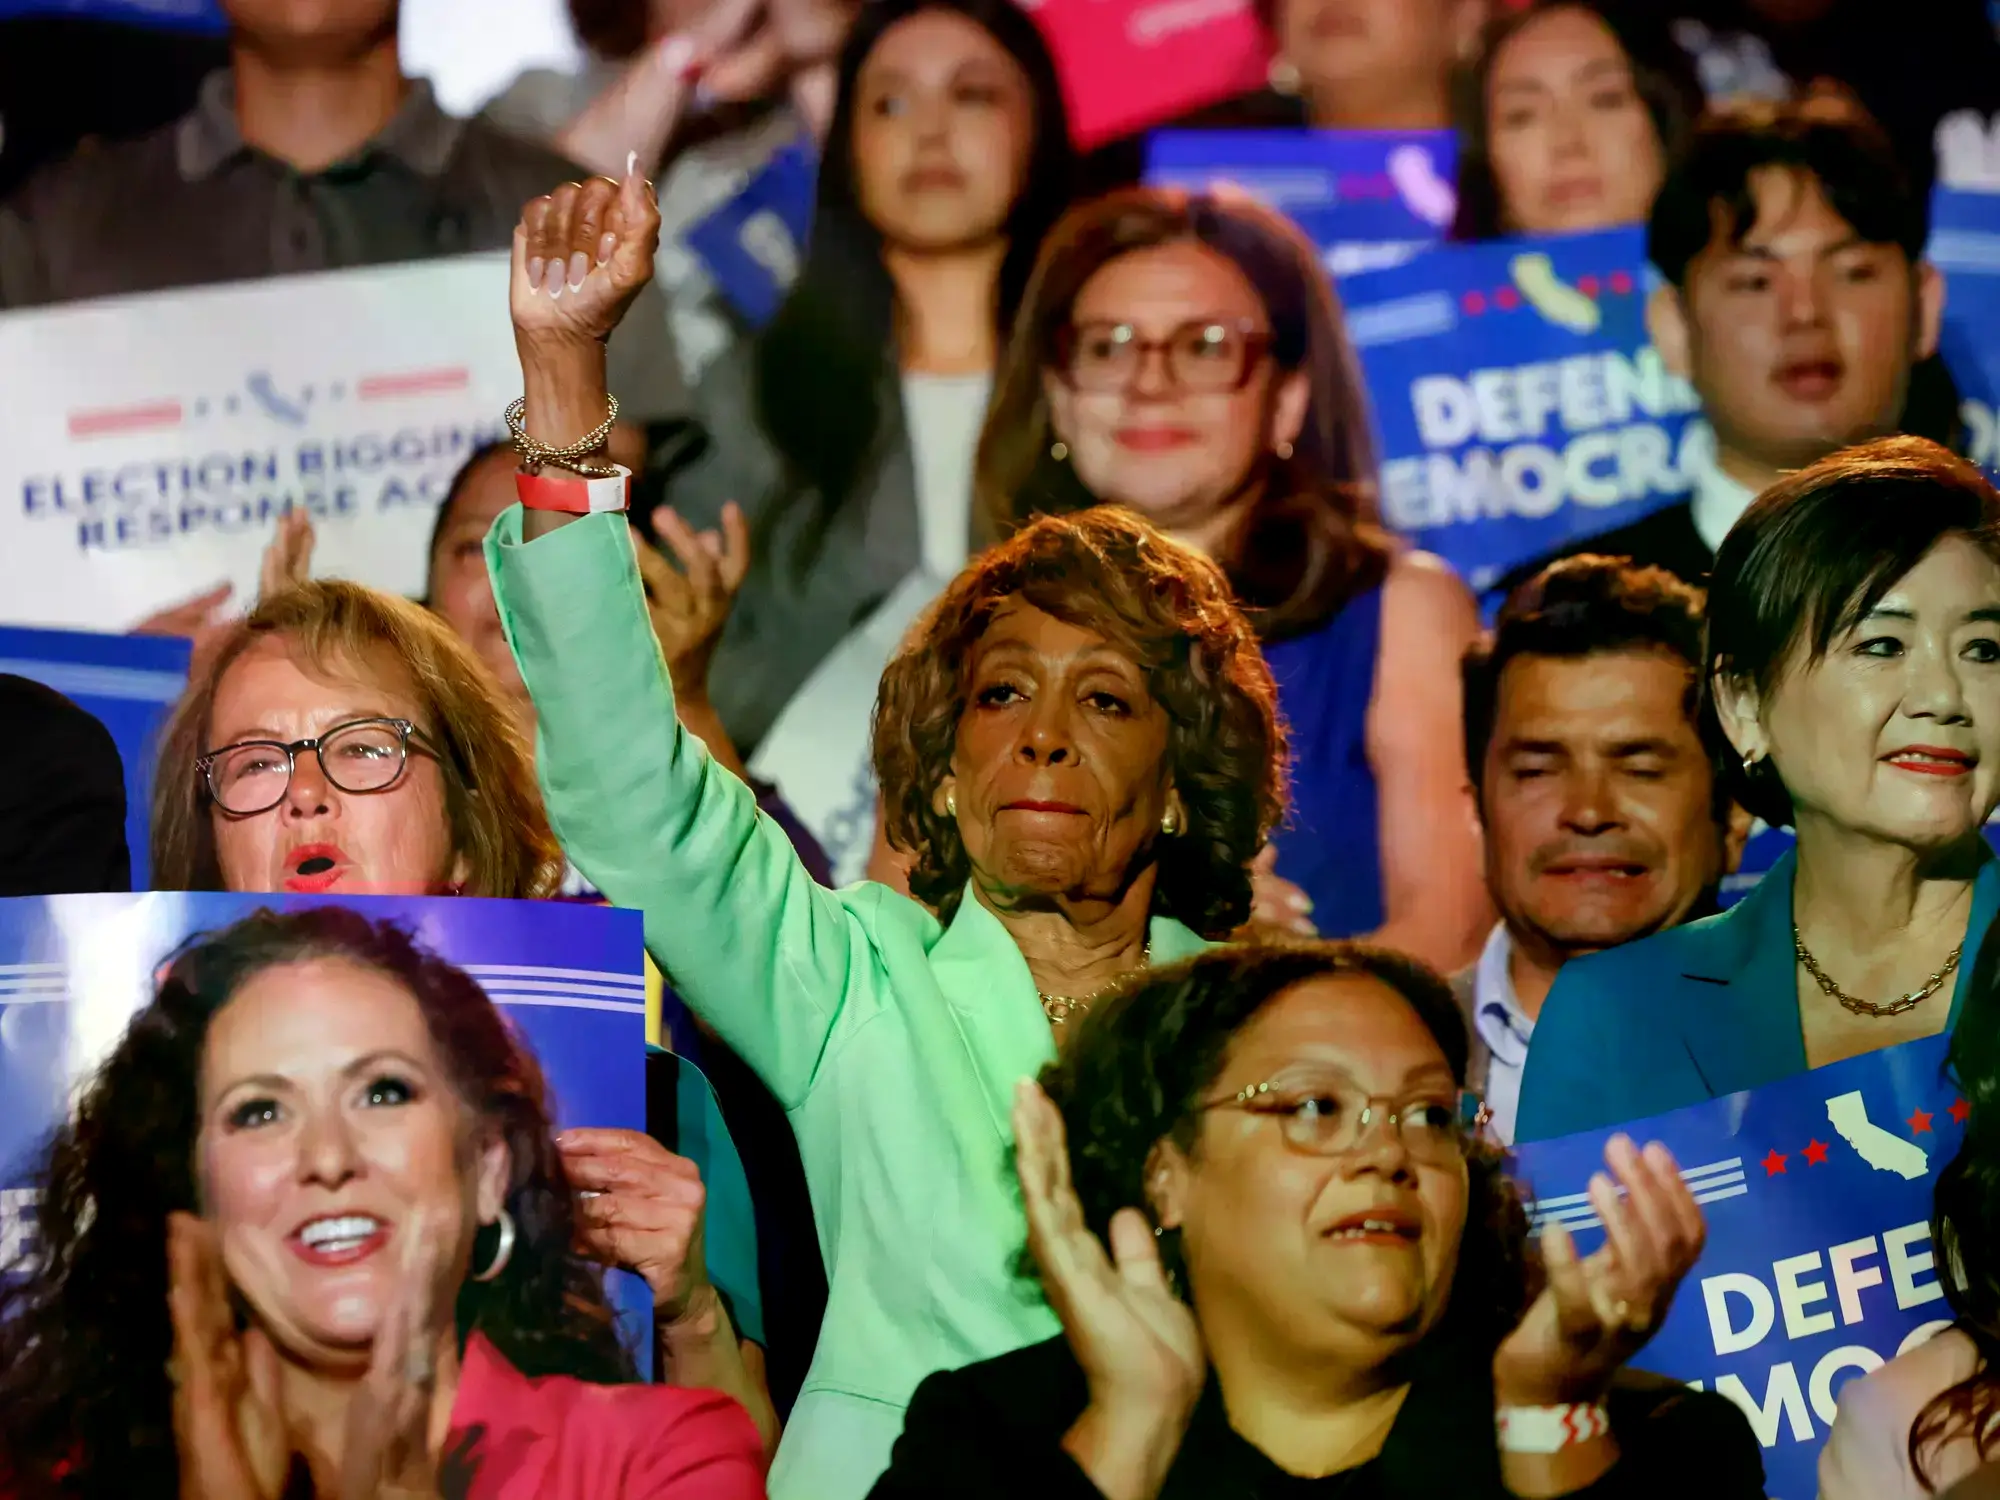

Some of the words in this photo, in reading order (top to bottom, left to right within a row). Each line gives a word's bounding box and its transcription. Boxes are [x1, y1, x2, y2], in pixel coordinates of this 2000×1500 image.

[22, 448, 280, 519] ELECTION
[78, 482, 360, 550] RESPONSE
[1701, 1220, 1944, 1356] DEFE
